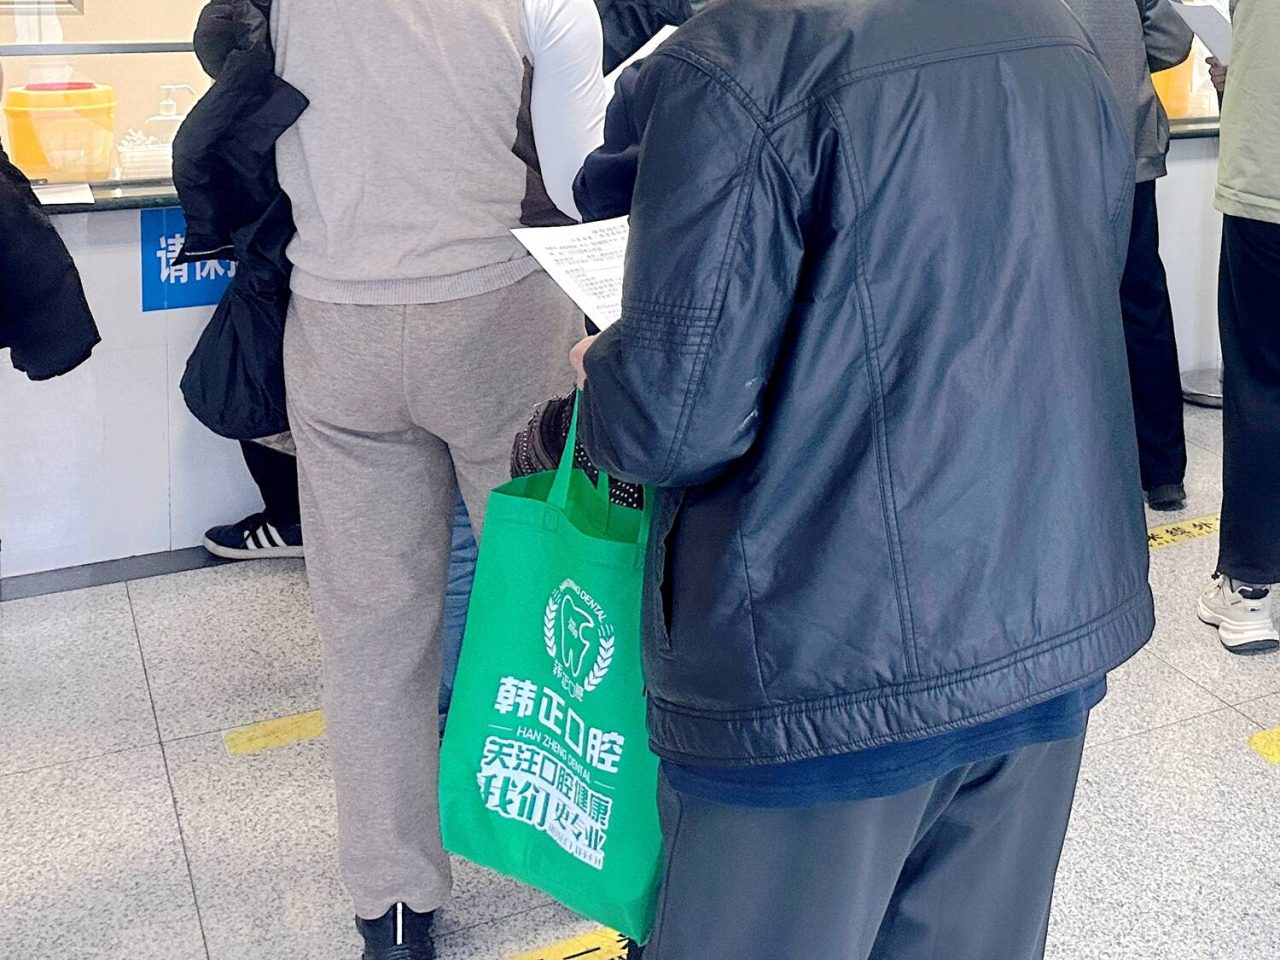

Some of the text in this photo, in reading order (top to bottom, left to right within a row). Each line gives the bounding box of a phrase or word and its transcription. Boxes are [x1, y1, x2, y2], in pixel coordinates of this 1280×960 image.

[493, 675, 625, 775] 韩正口腔
[517, 725, 592, 784] HAN ZHENG DENTAL
[483, 739, 612, 826] 关注口腔健康
